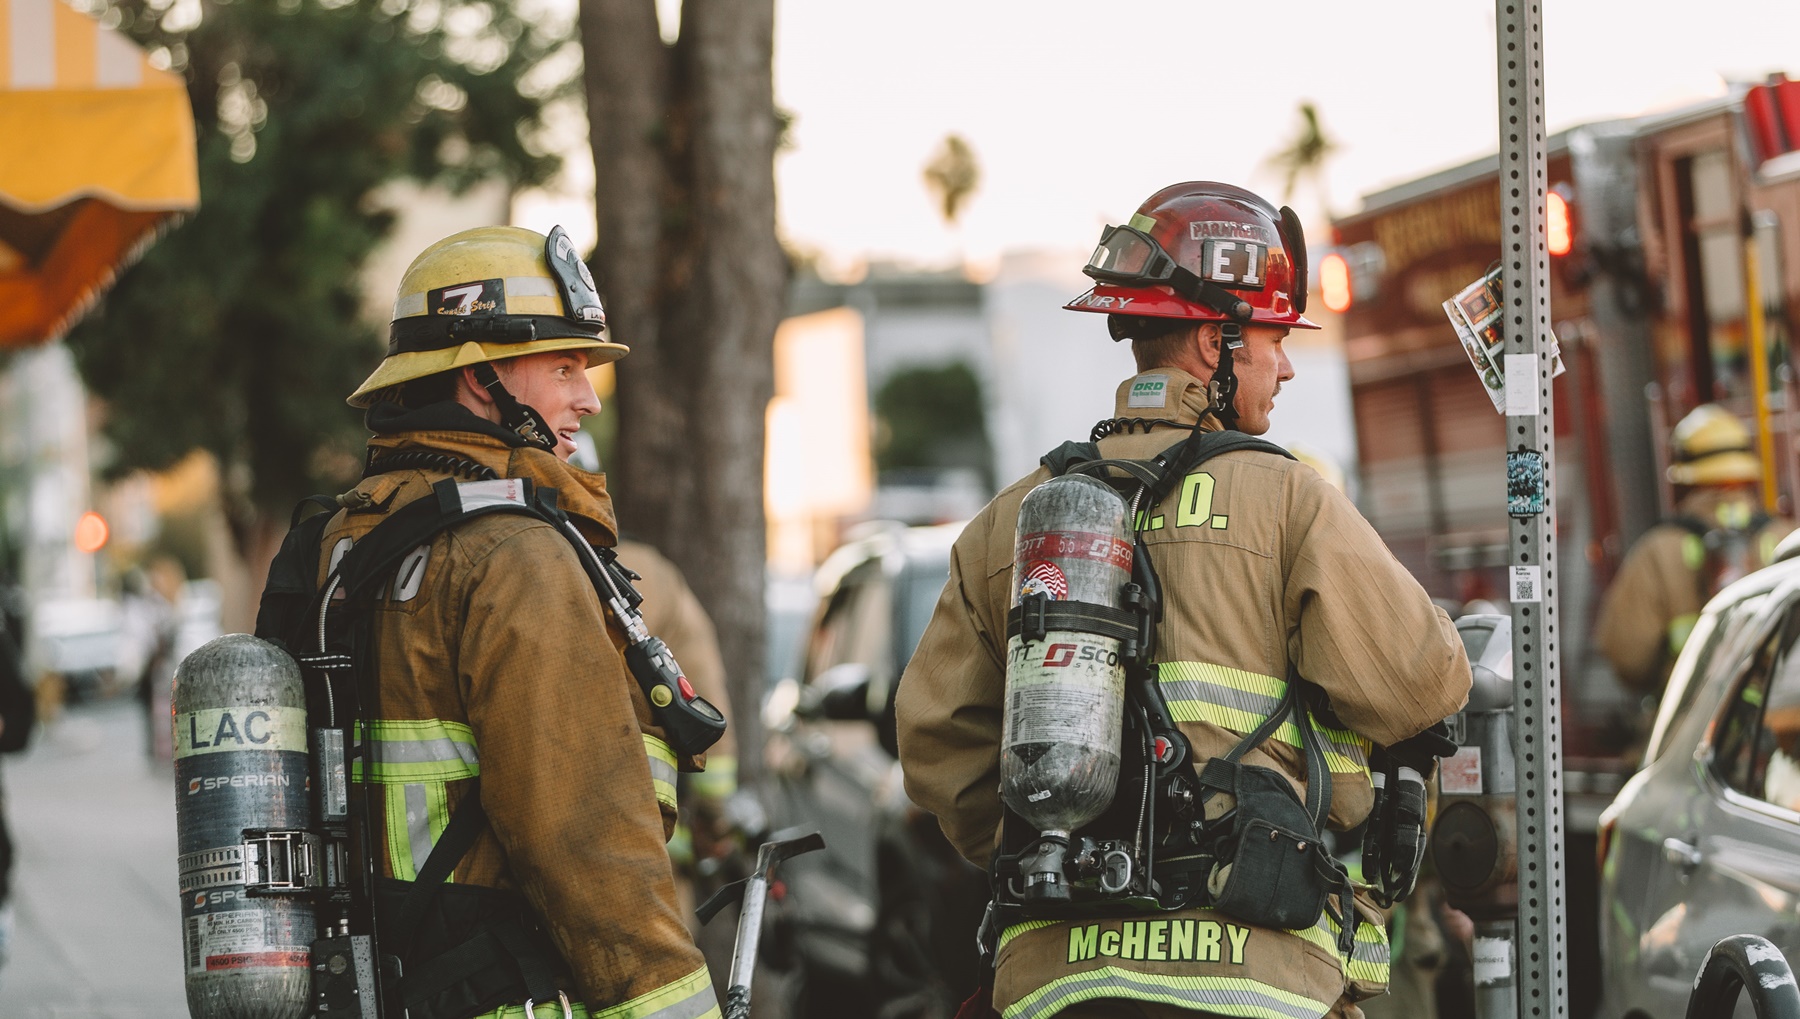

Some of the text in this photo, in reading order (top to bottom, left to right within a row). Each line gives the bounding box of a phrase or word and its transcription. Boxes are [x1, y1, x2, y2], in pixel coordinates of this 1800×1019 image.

[1193, 222, 1270, 242] PARAMEDIC
[1212, 241, 1259, 284] E1
[444, 284, 483, 315] 7
[470, 300, 497, 313] Strip
[1073, 292, 1134, 309] NRY
[1134, 382, 1164, 391] DRD
[1078, 645, 1118, 667] SCO
[190, 711, 271, 749] LAC
[204, 775, 290, 791] SPERIAN
[209, 889, 247, 904] SPE
[215, 911, 259, 921] SPERIAN
[1067, 919, 1251, 965] McHENRY
[211, 956, 253, 966] 4500 PSIG
